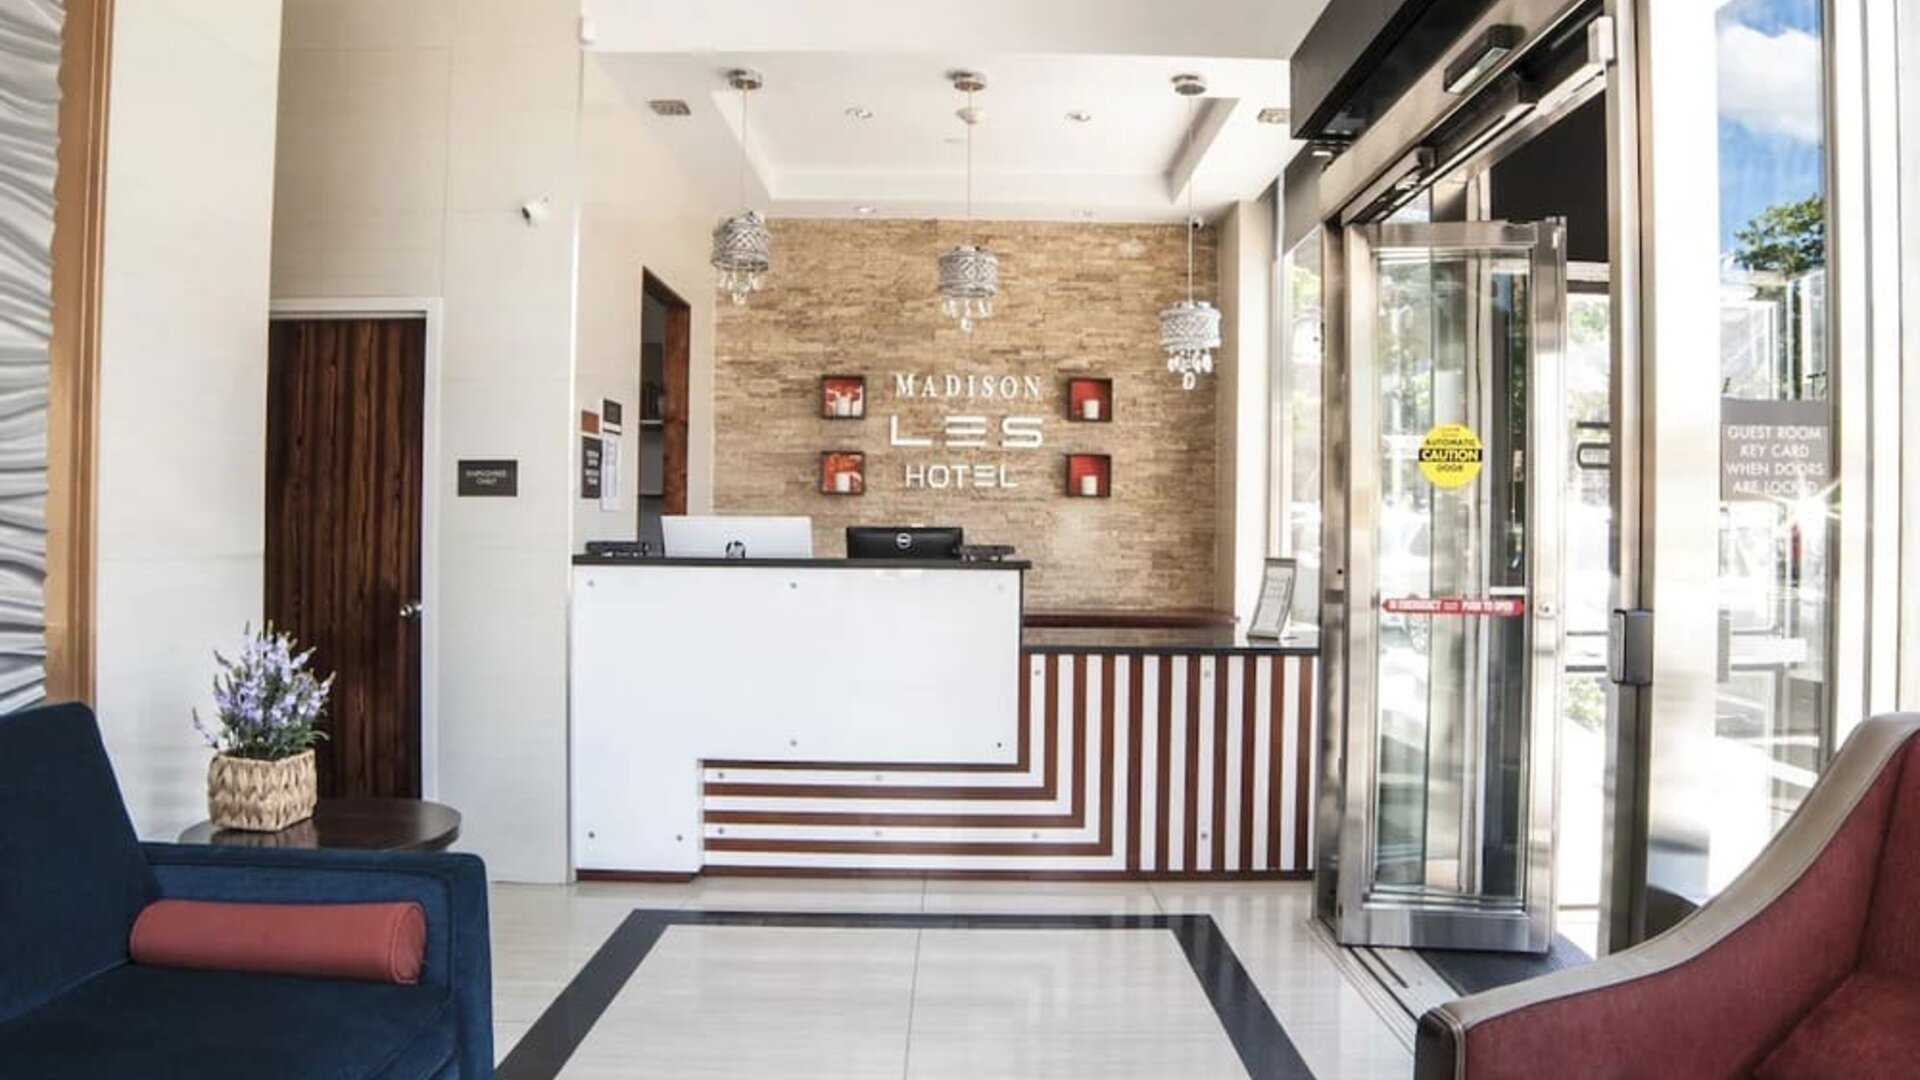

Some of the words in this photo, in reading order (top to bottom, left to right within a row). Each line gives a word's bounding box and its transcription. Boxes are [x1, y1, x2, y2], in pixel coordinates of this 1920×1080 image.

[895, 373, 1043, 398] MADISON
[889, 415, 1043, 448] LES
[1727, 425, 1771, 439] GUEST
[1777, 426, 1822, 439] ROOM
[1422, 450, 1478, 461] CAUTION
[1740, 444, 1767, 457] KEY
[1772, 444, 1809, 457] CARD
[1726, 462, 1769, 475] WHEN
[1775, 462, 1824, 475] DOORS
[905, 464, 1018, 488] HOTEL
[1733, 481, 1760, 494] ARE
